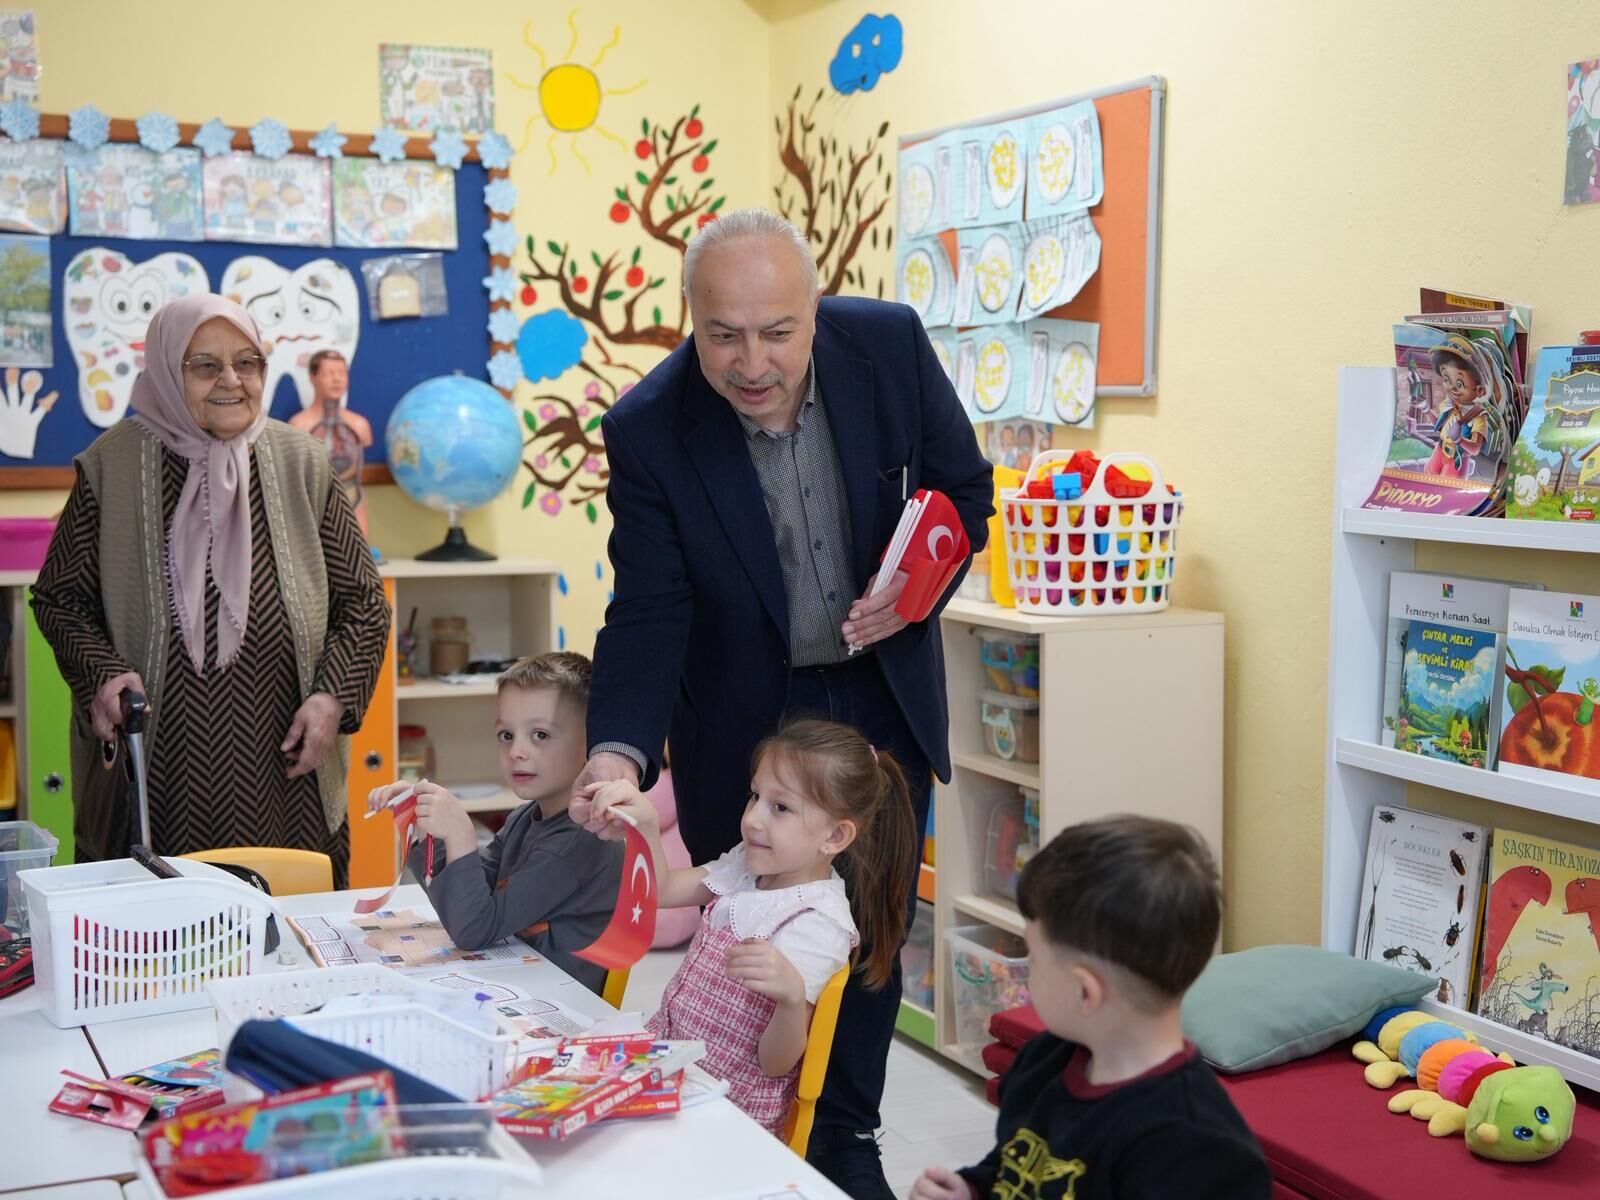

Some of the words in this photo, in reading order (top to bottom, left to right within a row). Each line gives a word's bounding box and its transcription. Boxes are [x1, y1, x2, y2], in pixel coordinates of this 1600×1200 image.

[1405, 604, 1440, 620] Pencereye
[1442, 610, 1469, 623] Konan
[1472, 612, 1490, 625] Saat
[1450, 634, 1473, 647] MELKİ
[1513, 621, 1540, 634] Davulcu
[1543, 625, 1566, 637] Olmak
[1567, 625, 1592, 642] İsteyen
[1418, 652, 1449, 667] SEVİMLİ
[1502, 839, 1545, 861] ŞAŞKIN
